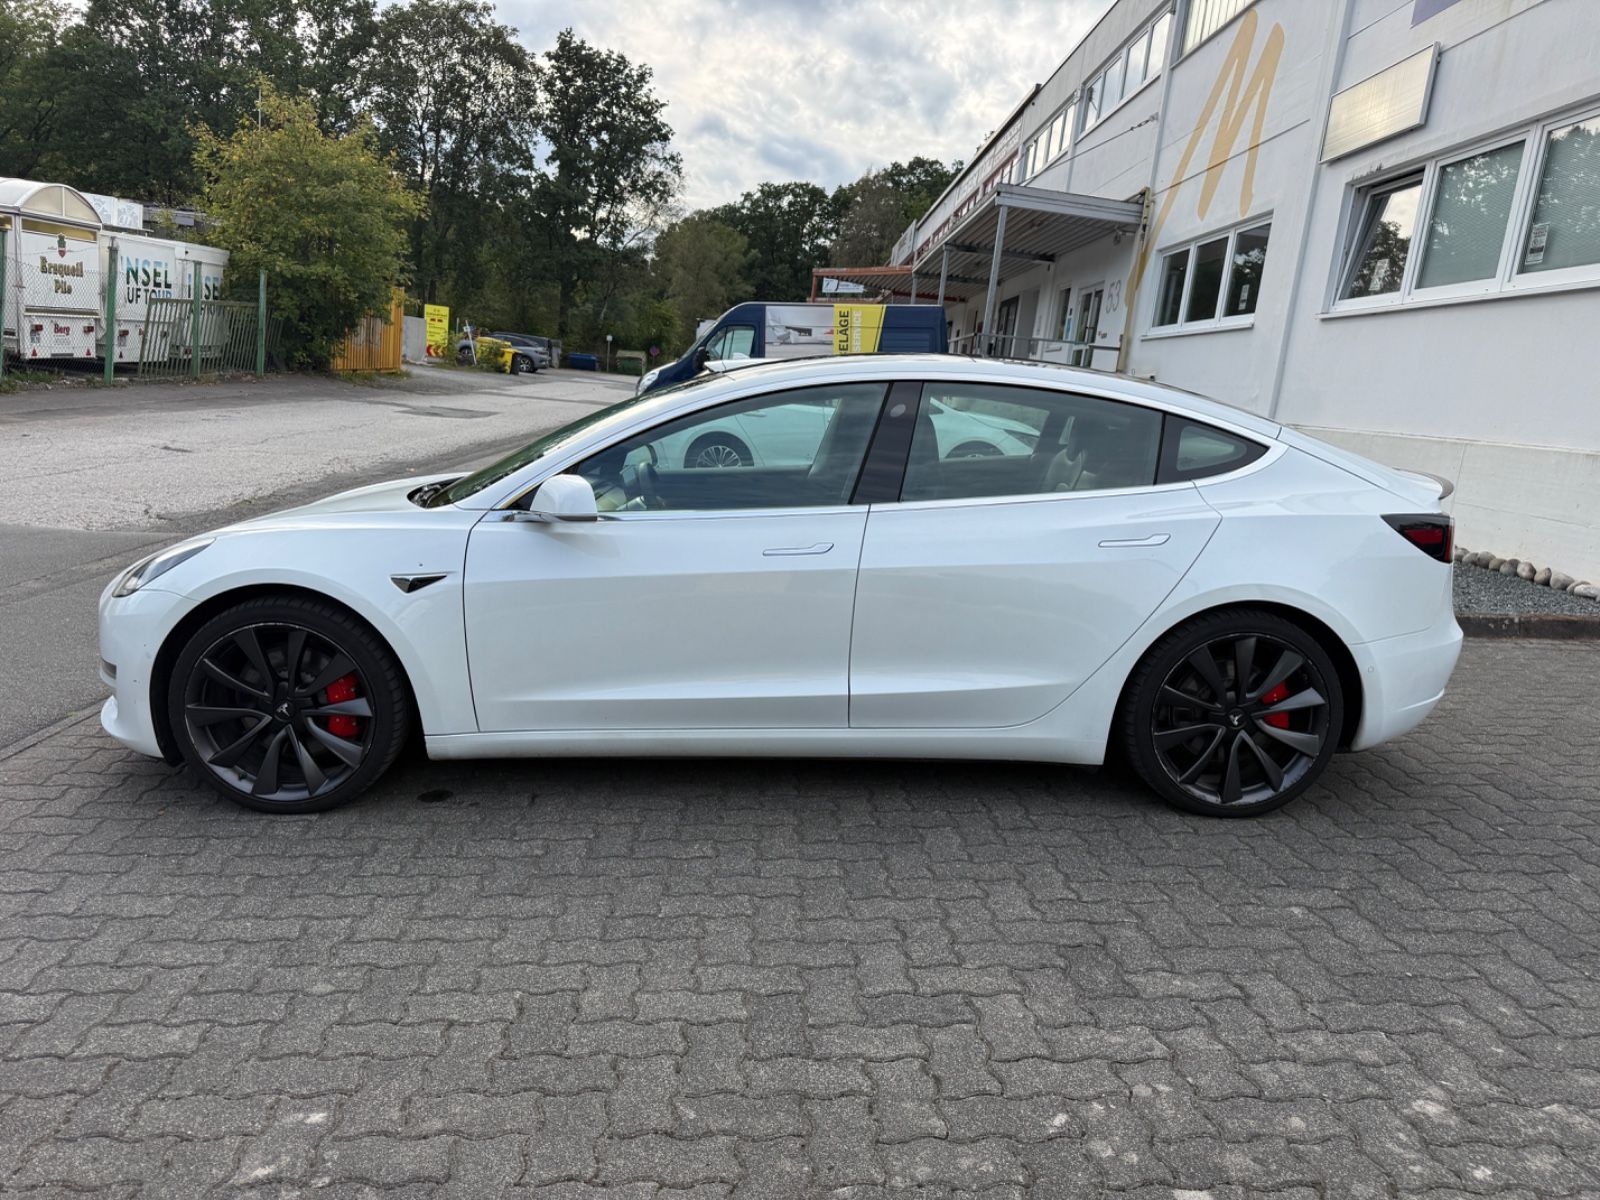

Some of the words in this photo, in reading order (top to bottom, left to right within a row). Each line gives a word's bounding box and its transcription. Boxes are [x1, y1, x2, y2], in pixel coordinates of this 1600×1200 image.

[125, 287, 141, 304] UF
[1106, 280, 1121, 314] 53
[837, 310, 849, 355] ELÄGE
